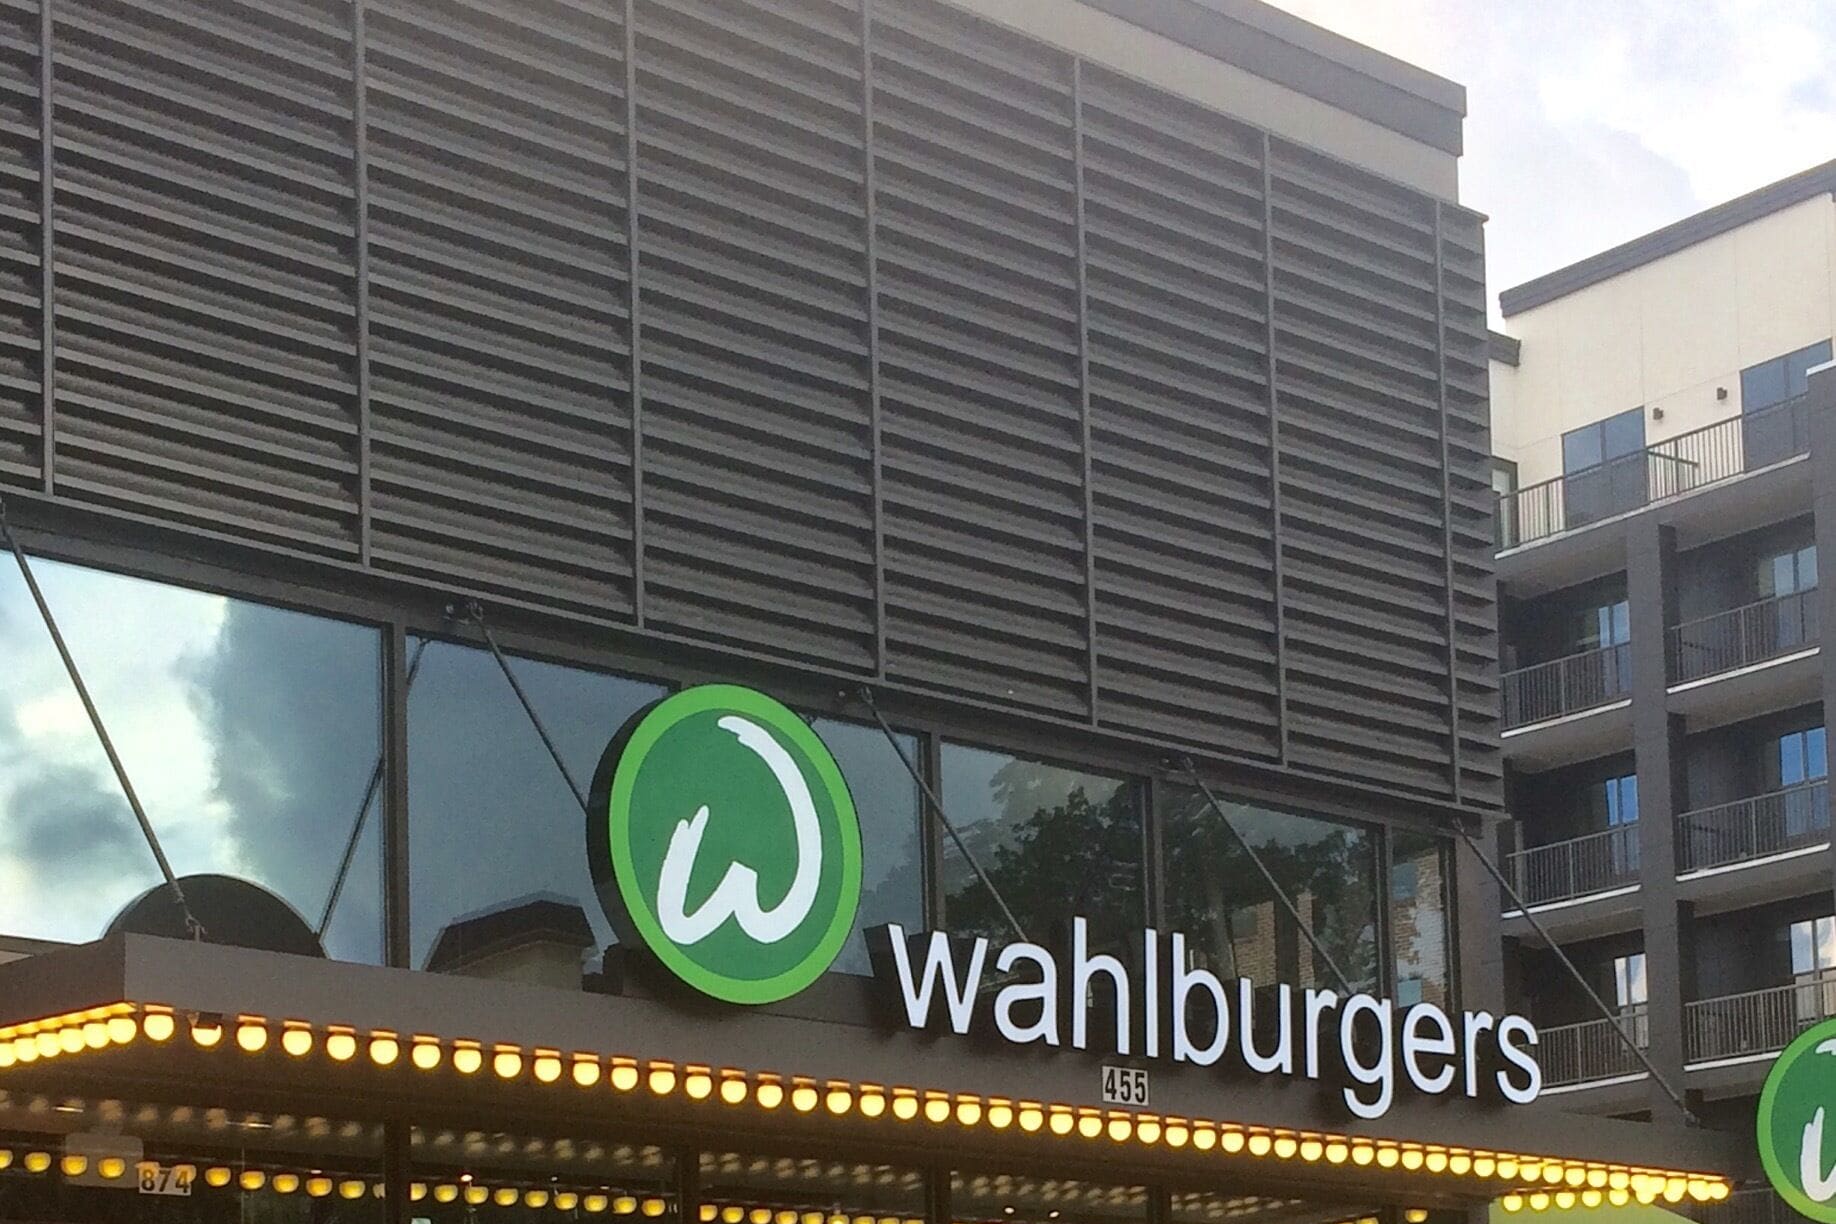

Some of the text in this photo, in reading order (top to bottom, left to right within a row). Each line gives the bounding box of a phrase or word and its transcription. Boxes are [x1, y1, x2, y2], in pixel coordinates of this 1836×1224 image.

[887, 916, 1542, 1119] wahlburgers
[1105, 1069, 1146, 1103] 455
[141, 1169, 190, 1194] 874
